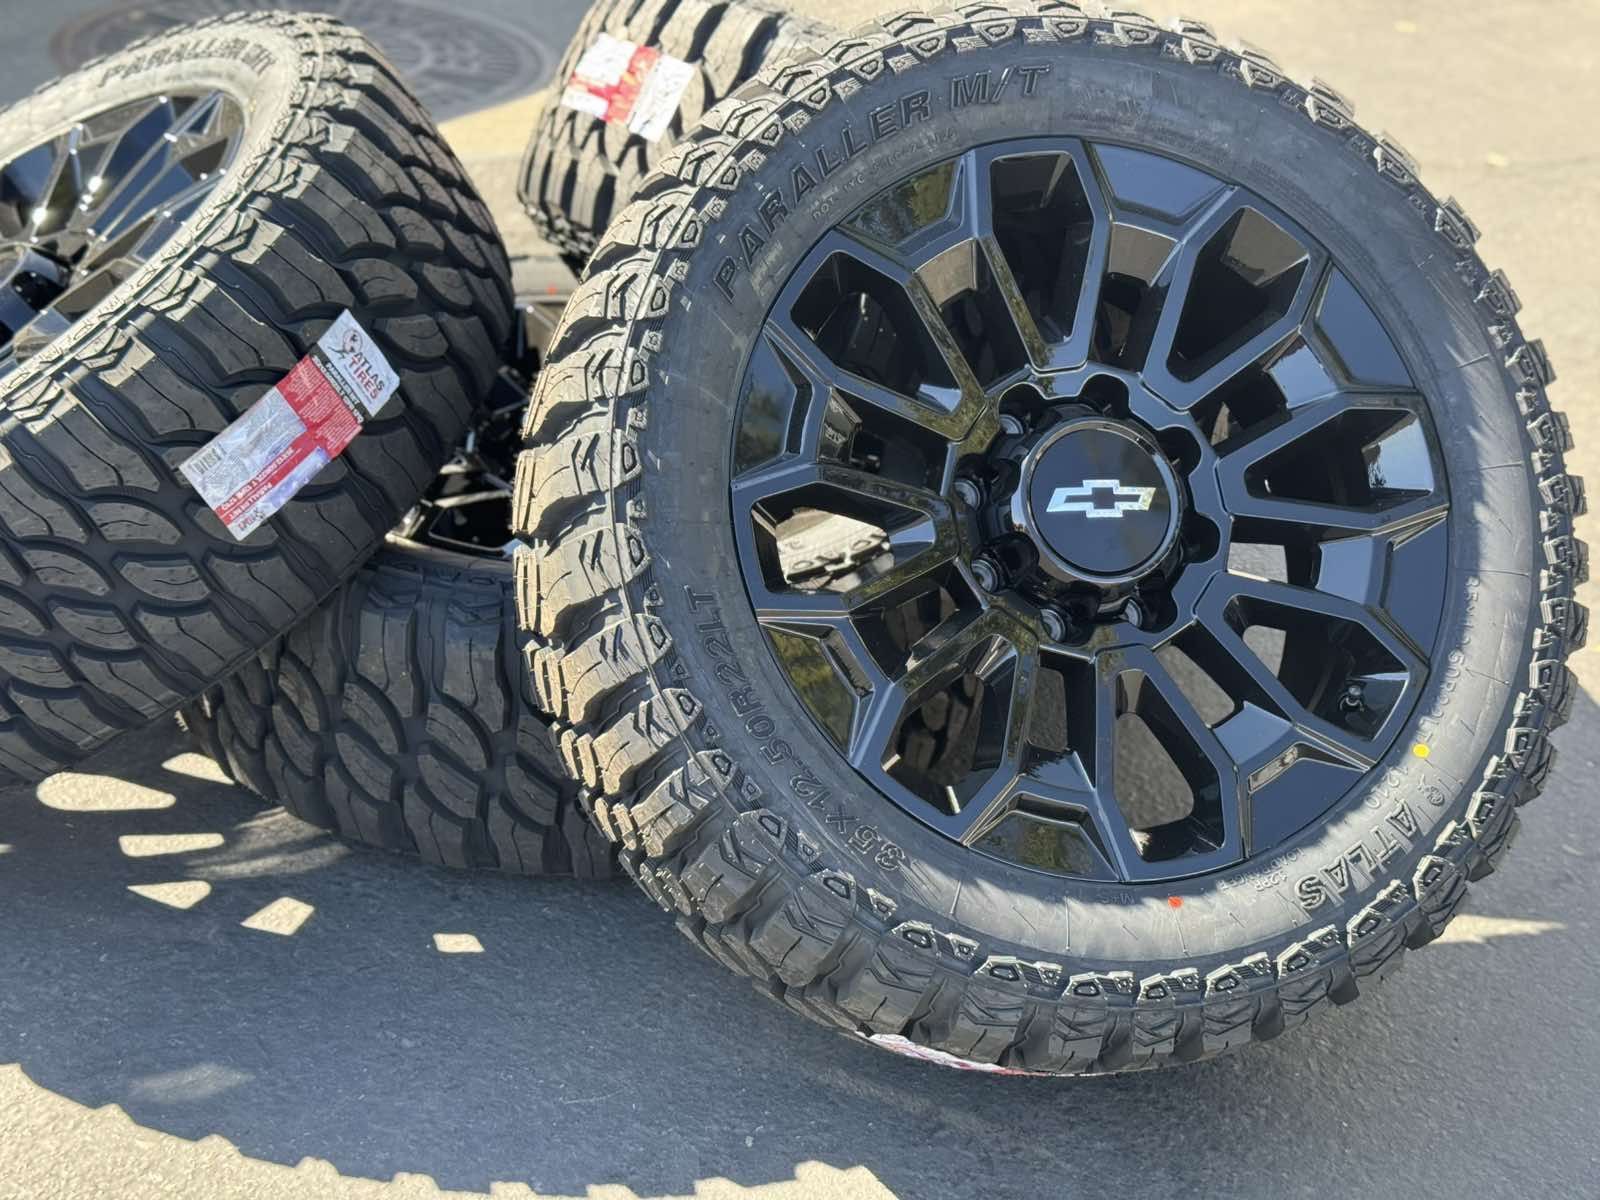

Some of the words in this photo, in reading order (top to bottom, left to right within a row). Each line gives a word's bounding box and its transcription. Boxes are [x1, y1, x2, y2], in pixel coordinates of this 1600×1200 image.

[711, 88, 933, 304] PARALLER
[949, 63, 1051, 109] M/T
[349, 358, 378, 400] TIRES
[353, 352, 386, 392] ATLAS
[1294, 798, 1418, 911] ATLAS
